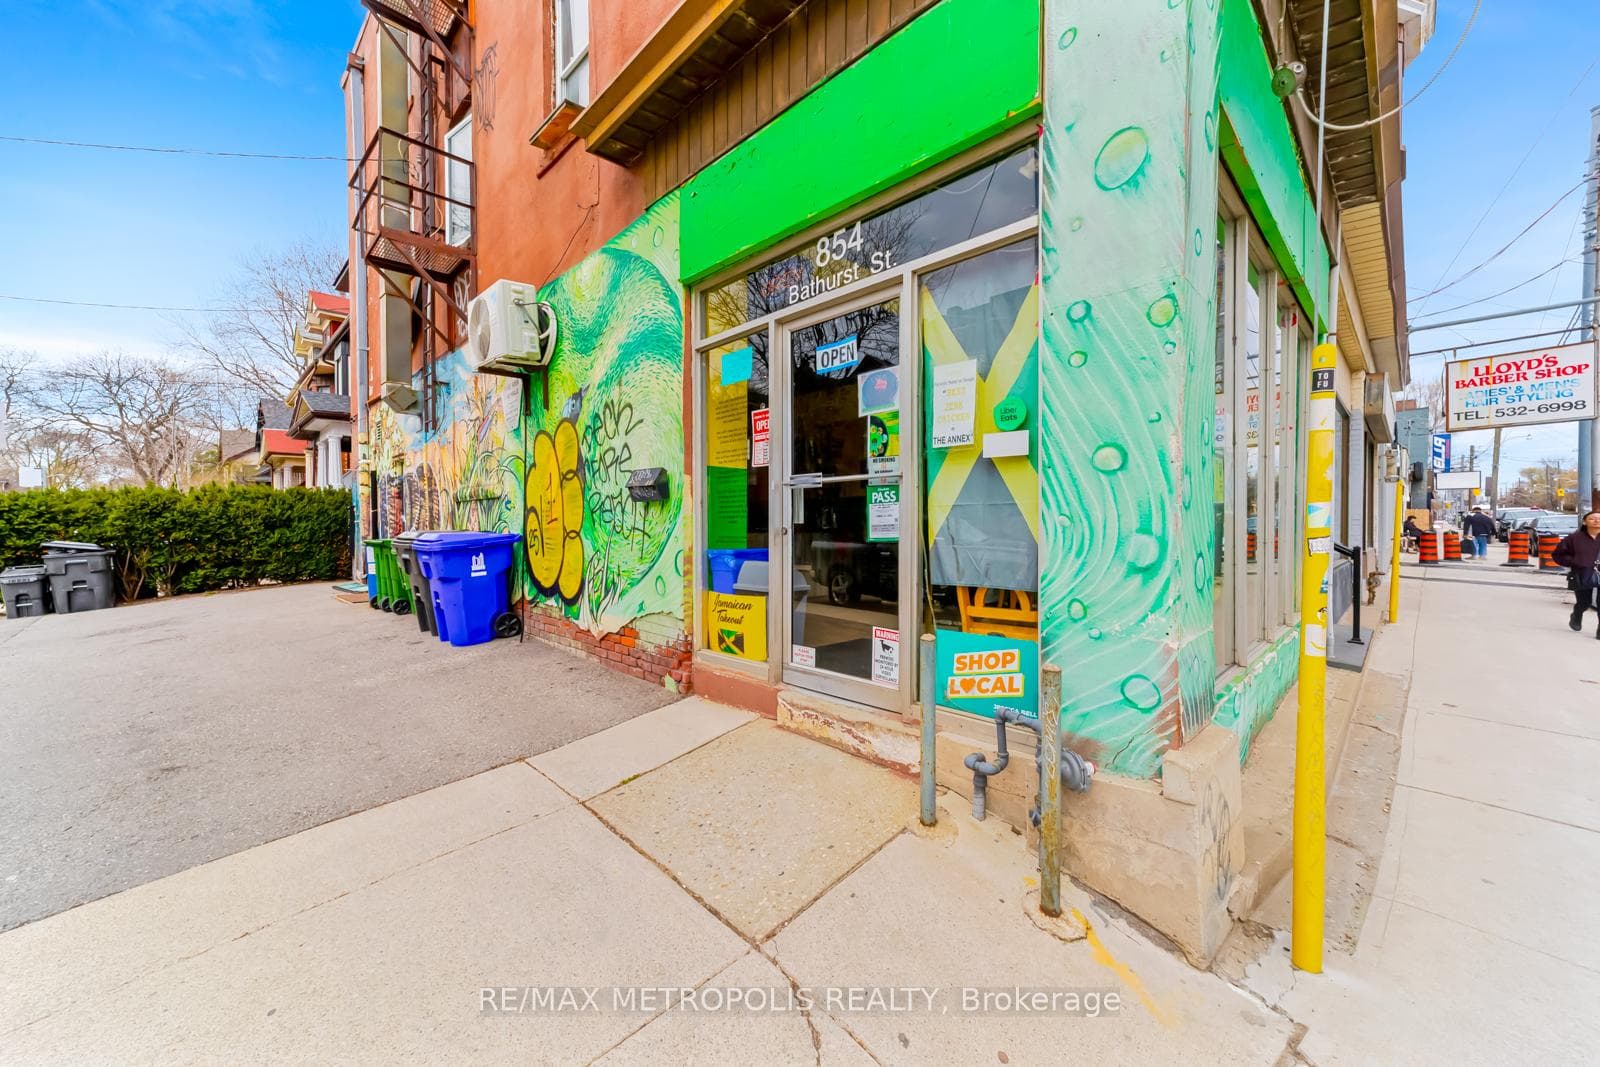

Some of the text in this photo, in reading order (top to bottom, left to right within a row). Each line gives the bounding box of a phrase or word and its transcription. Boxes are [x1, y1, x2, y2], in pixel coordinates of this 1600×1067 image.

[816, 221, 863, 267] 854
[789, 265, 859, 304] Bathurst
[871, 250, 897, 275] St.
[821, 342, 855, 368] OPEN
[1474, 354, 1558, 377] LLOYD'S
[1317, 372, 1329, 380] TO
[1317, 380, 1328, 388] FU
[1456, 363, 1590, 389] BARBER SHOP
[1465, 389, 1573, 408] HAIR STYLING
[1000, 414, 1018, 422] Eats
[1454, 400, 1587, 422] TEL. 532-6998
[756, 420, 769, 431] OPE
[933, 436, 946, 445] THE
[872, 491, 896, 503] PASS
[712, 594, 752, 612] Jamaican
[717, 610, 744, 625] Takeout
[875, 630, 899, 641] WARNING
[955, 652, 1015, 671] SHOP
